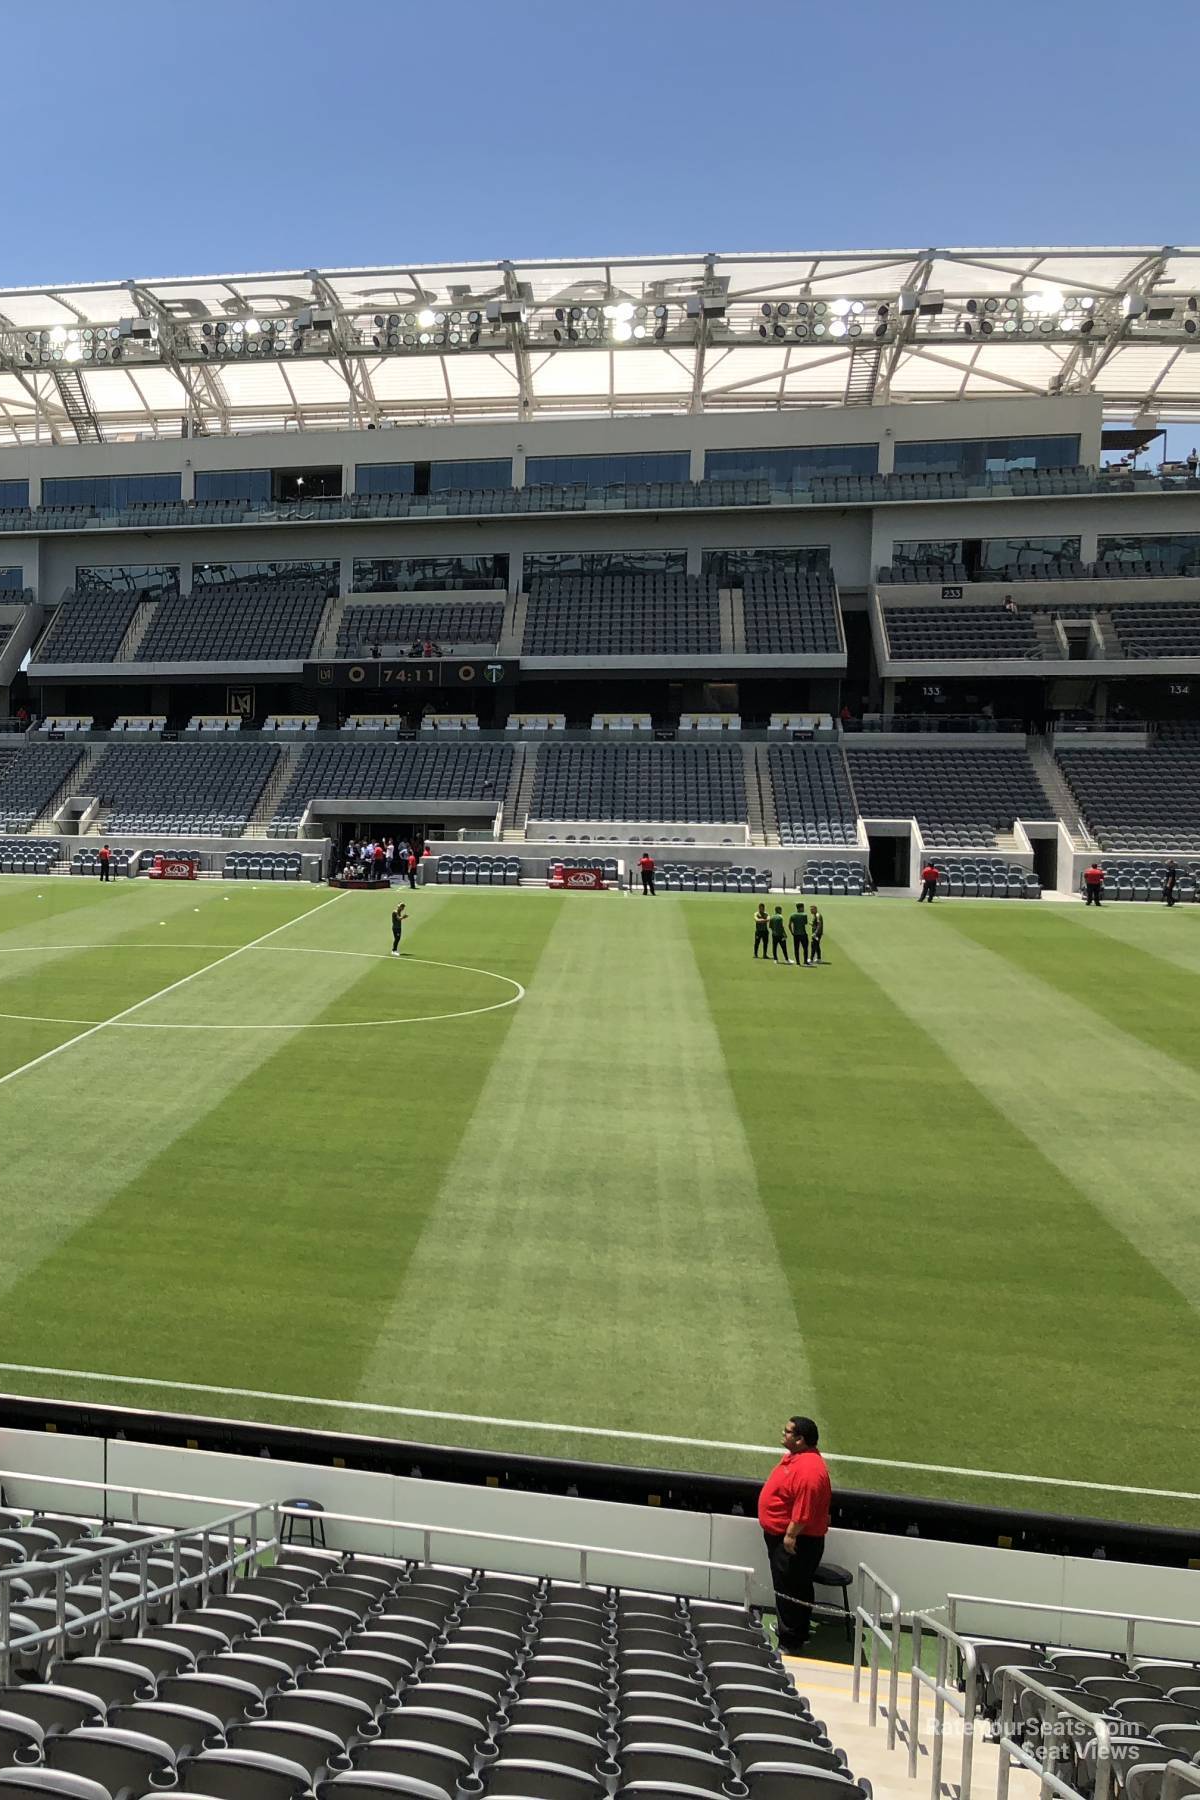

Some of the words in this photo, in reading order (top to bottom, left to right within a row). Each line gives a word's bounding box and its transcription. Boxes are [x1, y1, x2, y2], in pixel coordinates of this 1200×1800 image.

[943, 589, 961, 598] 233
[383, 669, 434, 682] 74:11
[922, 687, 940, 695] 133
[1170, 685, 1189, 694] 134
